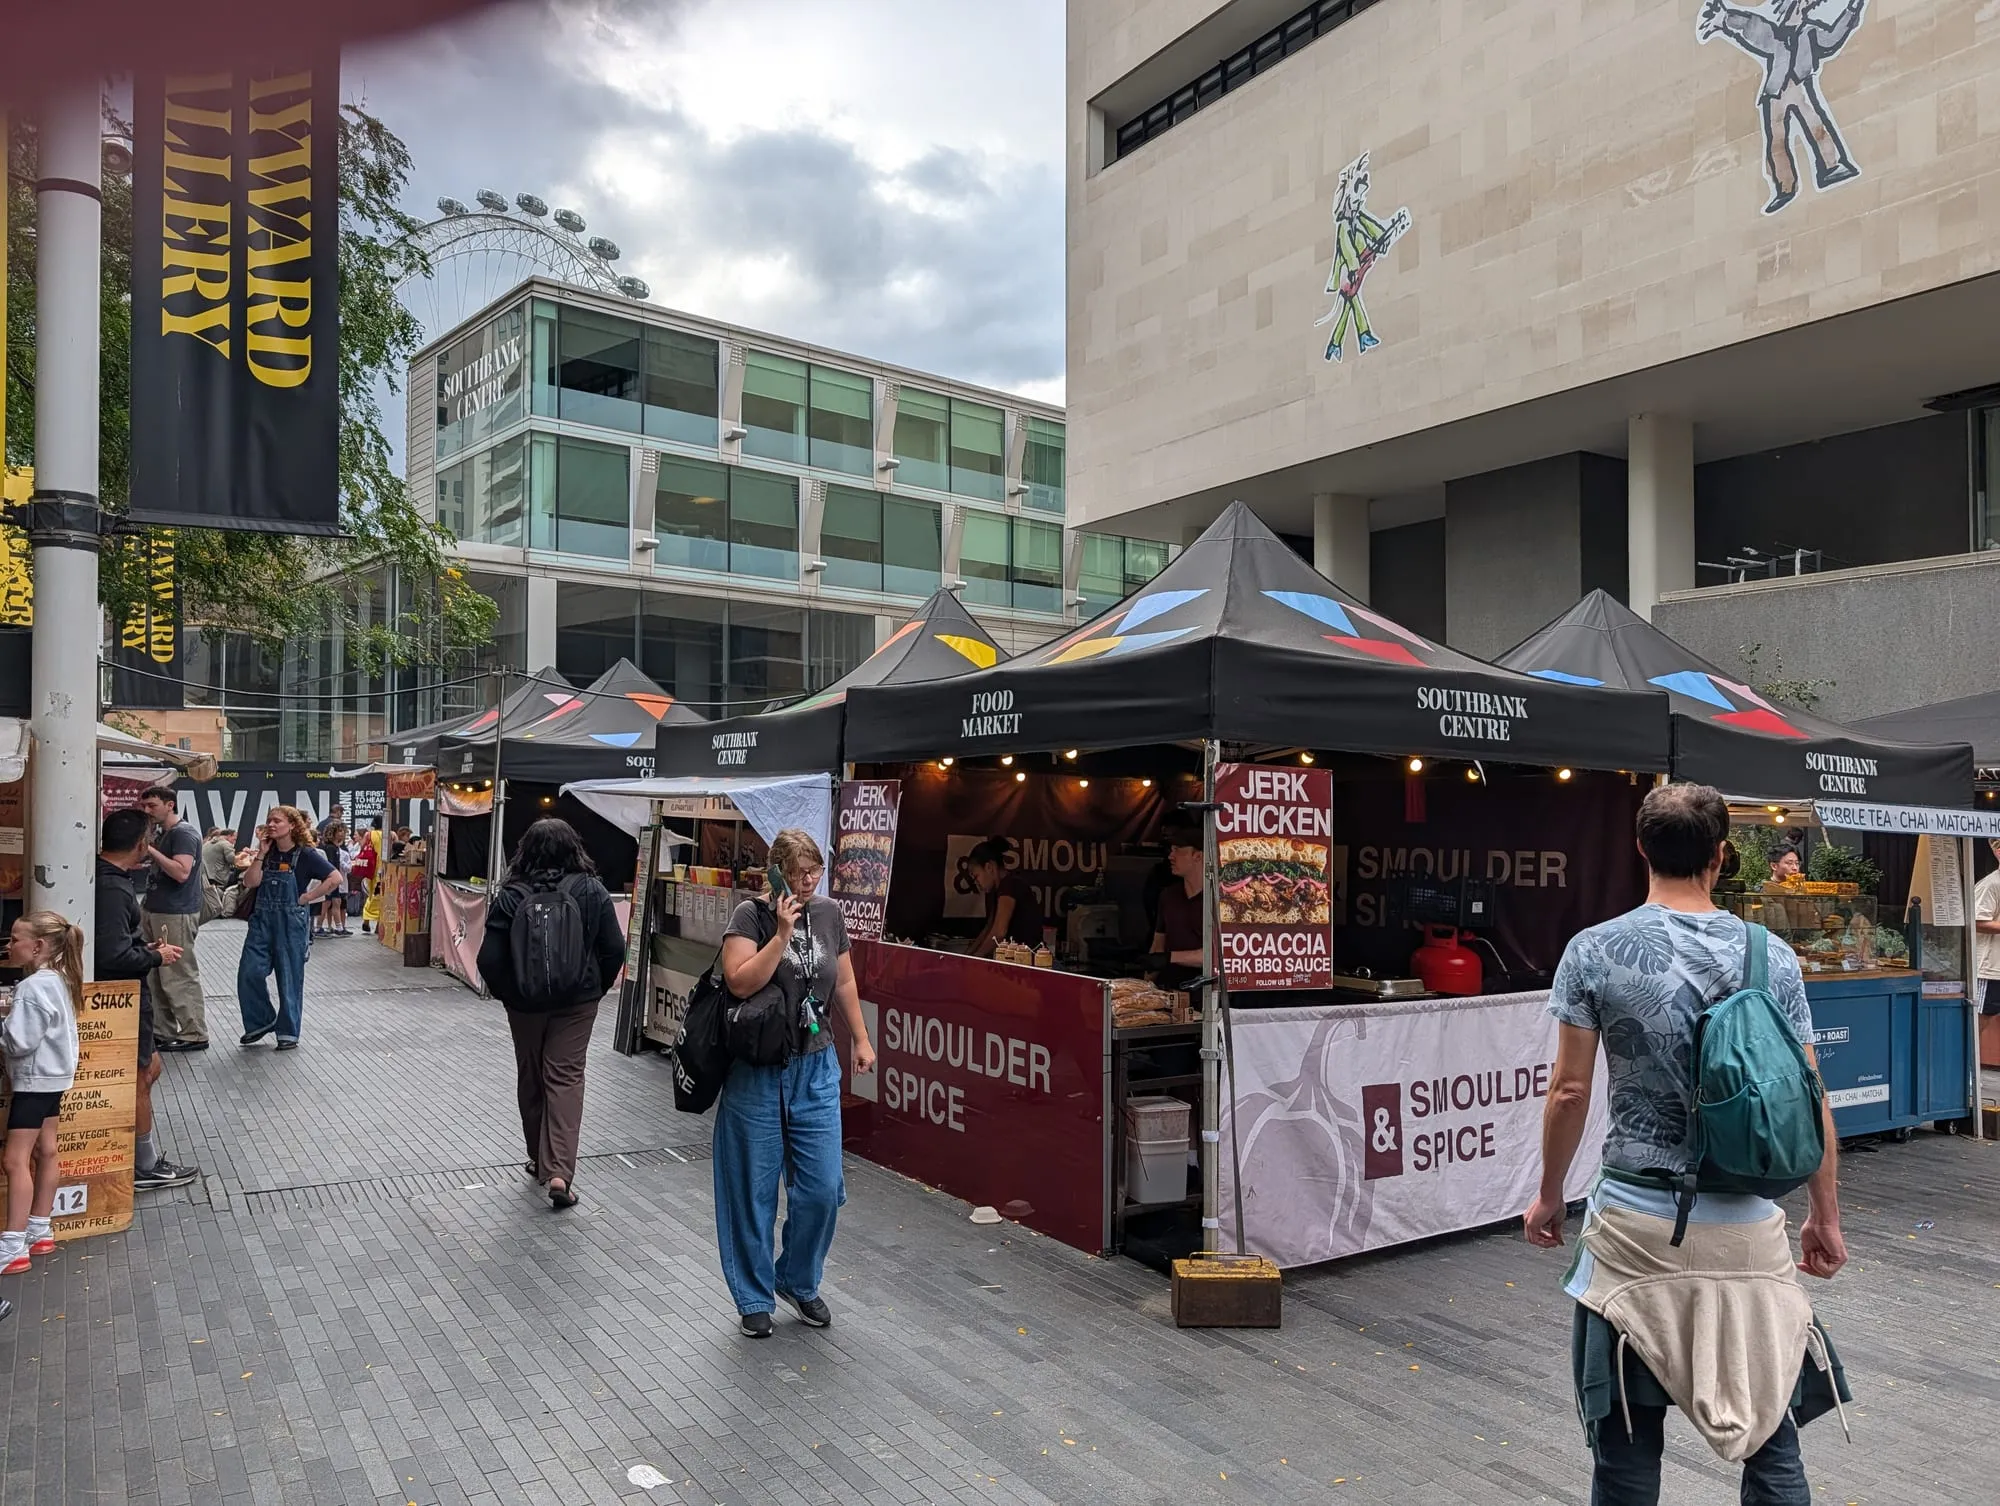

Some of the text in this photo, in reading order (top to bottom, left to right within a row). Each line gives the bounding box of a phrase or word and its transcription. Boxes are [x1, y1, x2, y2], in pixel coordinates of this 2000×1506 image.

[161, 72, 232, 360] LLERY
[247, 68, 314, 388] YWARD
[443, 335, 520, 402] SOUTHBANK
[457, 374, 505, 421] CENTRE
[972, 689, 1014, 715] FOOD
[1417, 686, 1528, 719] SOUTHBANK
[961, 713, 1022, 738] MARKET
[1439, 714, 1511, 741] CENTRE
[712, 731, 758, 749] SOUTHBANK
[717, 749, 747, 766] CENTRE
[1805, 752, 1878, 777] SOUTHBANK
[853, 785, 888, 806] JERK
[1240, 770, 1310, 802] JERK
[1819, 776, 1867, 795] CENTRE
[839, 809, 896, 831] CHICKEN
[1215, 802, 1331, 837] CHICKEN
[1868, 809, 1892, 827] TEA
[1900, 811, 1928, 830] CHAI
[1936, 813, 1983, 832] MATCHA
[838, 899, 881, 920] OCACCIA
[858, 919, 881, 932] SAUCE
[1221, 933, 1326, 956] FOCACCIA
[1255, 958, 1281, 973] BBQ
[1285, 957, 1330, 972] SAUCE
[91, 991, 134, 1010] SHACK
[656, 987, 687, 1021] FRES
[77, 1021, 106, 1031] BBEAN
[1827, 1030, 1847, 1040] ROAST
[885, 1008, 1051, 1094] SMOULDER
[74, 1068, 125, 1081] EET RECIPE
[71, 1090, 101, 1101] CAJUN
[885, 1066, 965, 1132] SPICE
[1410, 1062, 1556, 1118] SMOULDE
[1832, 1094, 1841, 1103] TEA
[1845, 1092, 1858, 1102] CHAI
[1862, 1089, 1883, 1098] MATCHA
[60, 1099, 112, 1112] MATO BASE,
[59, 1113, 76, 1122] EAT
[56, 1129, 110, 1142] PICE VEGGIE
[1371, 1106, 1398, 1153] &
[57, 1141, 88, 1153] CURRY
[1412, 1122, 1496, 1172] SPICE
[77, 1156, 109, 1167] SERVED
[112, 1154, 124, 1162] ON
[87, 1165, 105, 1174] RICE
[57, 1190, 84, 1211] 12
[59, 1220, 87, 1232] DAIRY
[90, 1216, 114, 1227] FREE
